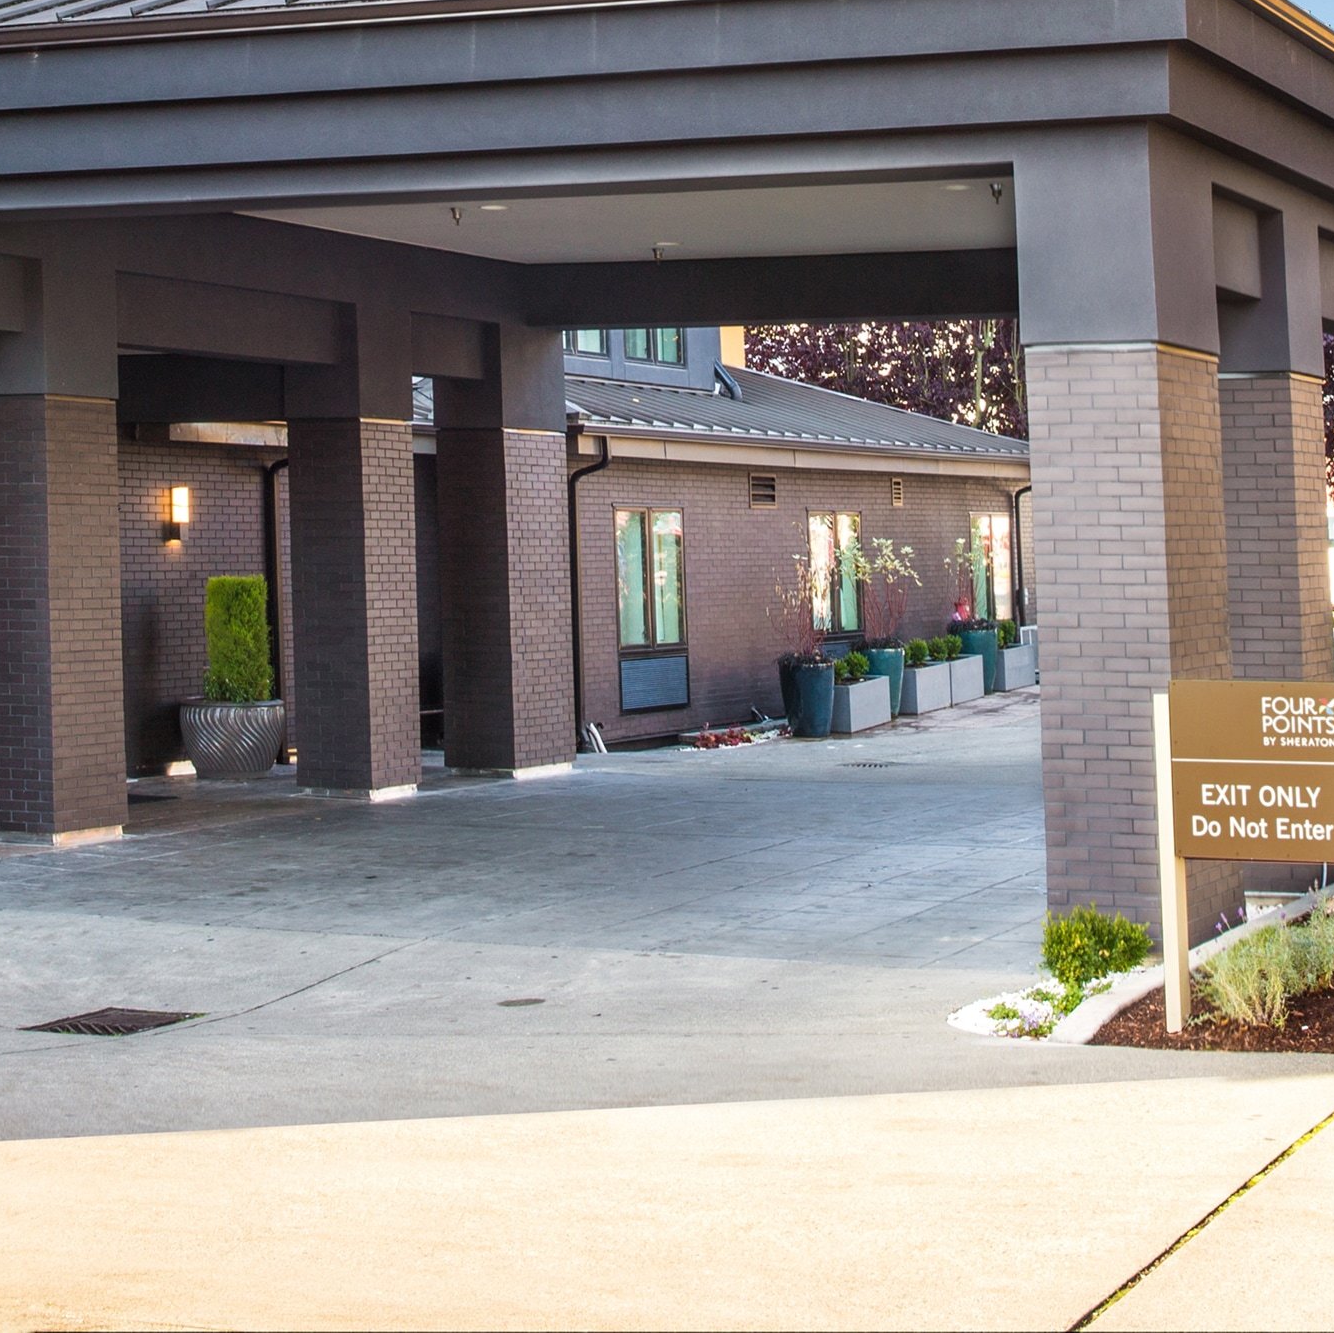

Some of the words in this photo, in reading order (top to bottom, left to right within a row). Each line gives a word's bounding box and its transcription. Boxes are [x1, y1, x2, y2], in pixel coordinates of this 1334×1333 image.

[1261, 696, 1318, 715] FOUR
[1263, 737, 1276, 746] BY
[1201, 784, 1251, 806] EXIT
[1259, 785, 1321, 808] ONLY
[1191, 815, 1221, 837] Do
[1229, 817, 1268, 839] Not
[1276, 818, 1334, 840] Enter
